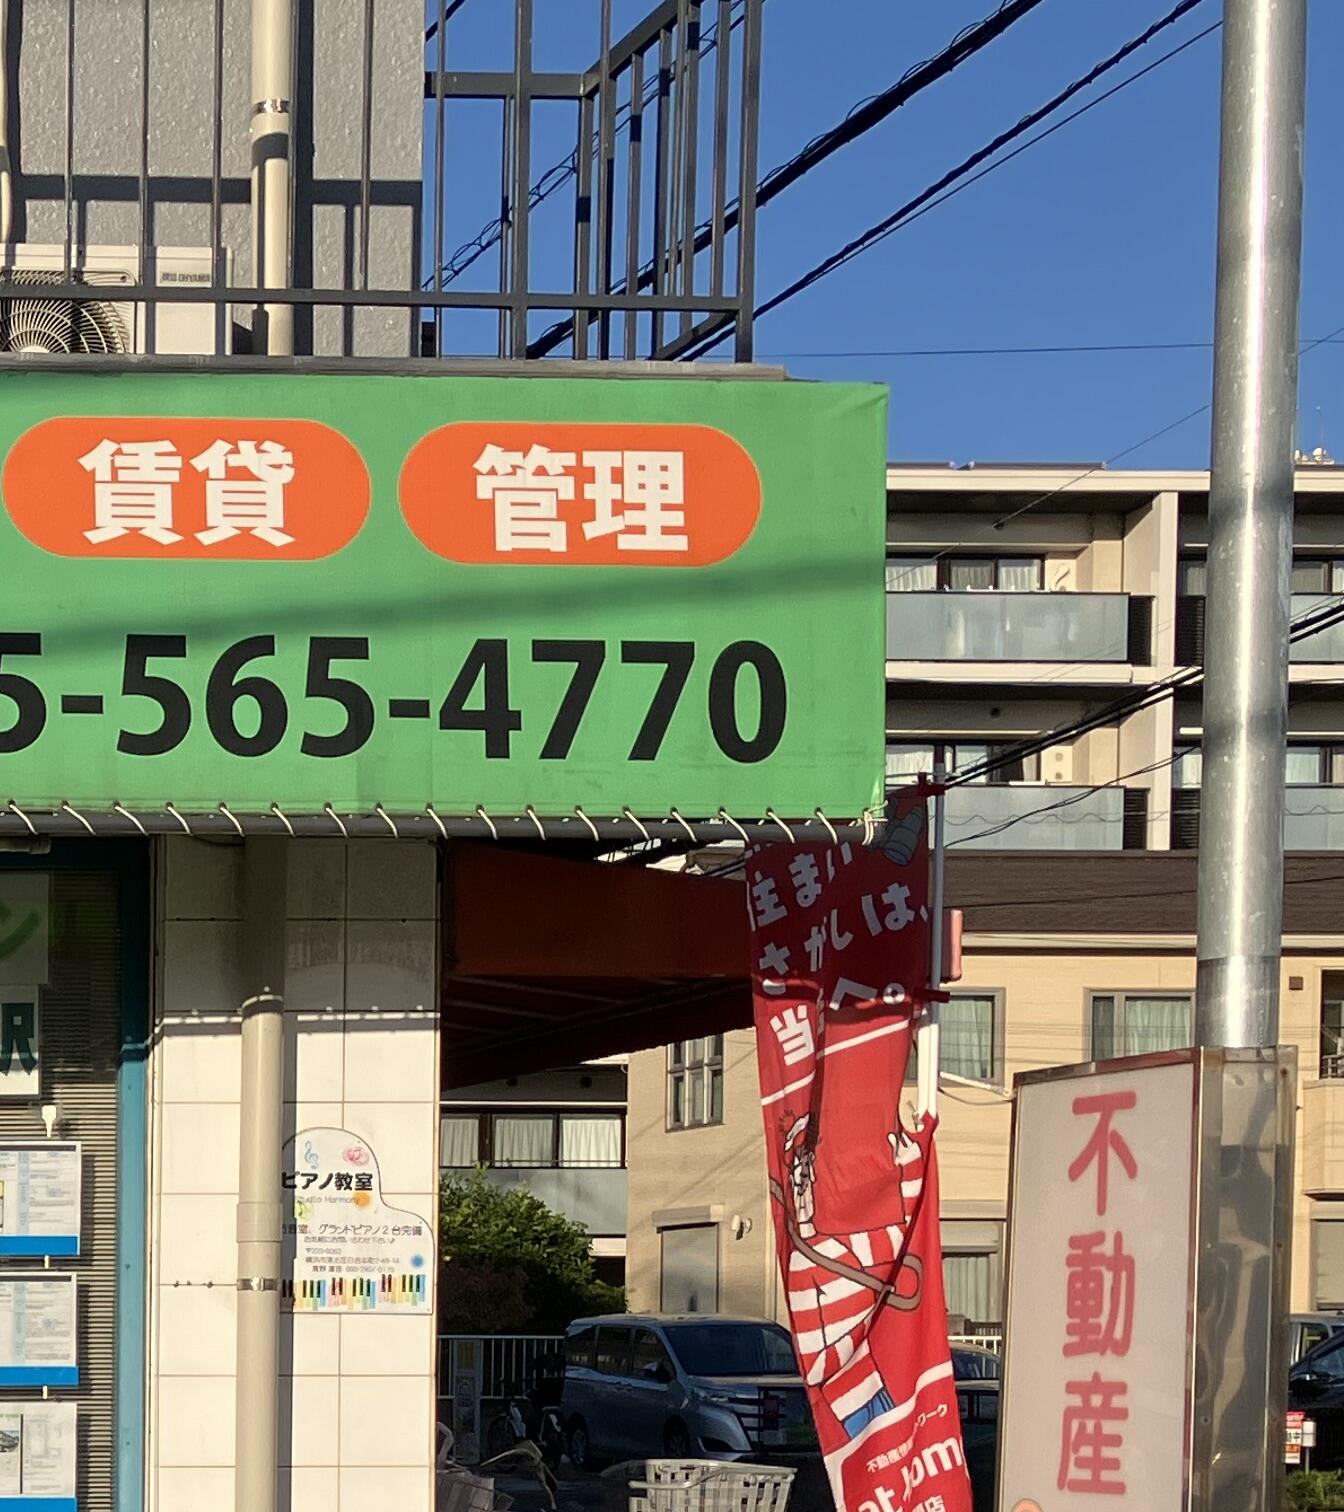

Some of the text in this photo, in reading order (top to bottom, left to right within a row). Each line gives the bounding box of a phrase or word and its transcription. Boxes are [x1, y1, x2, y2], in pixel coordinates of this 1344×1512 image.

[78, 439, 296, 548] 賃貸
[474, 444, 689, 554] 管理
[769, 976, 905, 1067] 当へ。
[1057, 1088, 1139, 1496] 不動産
